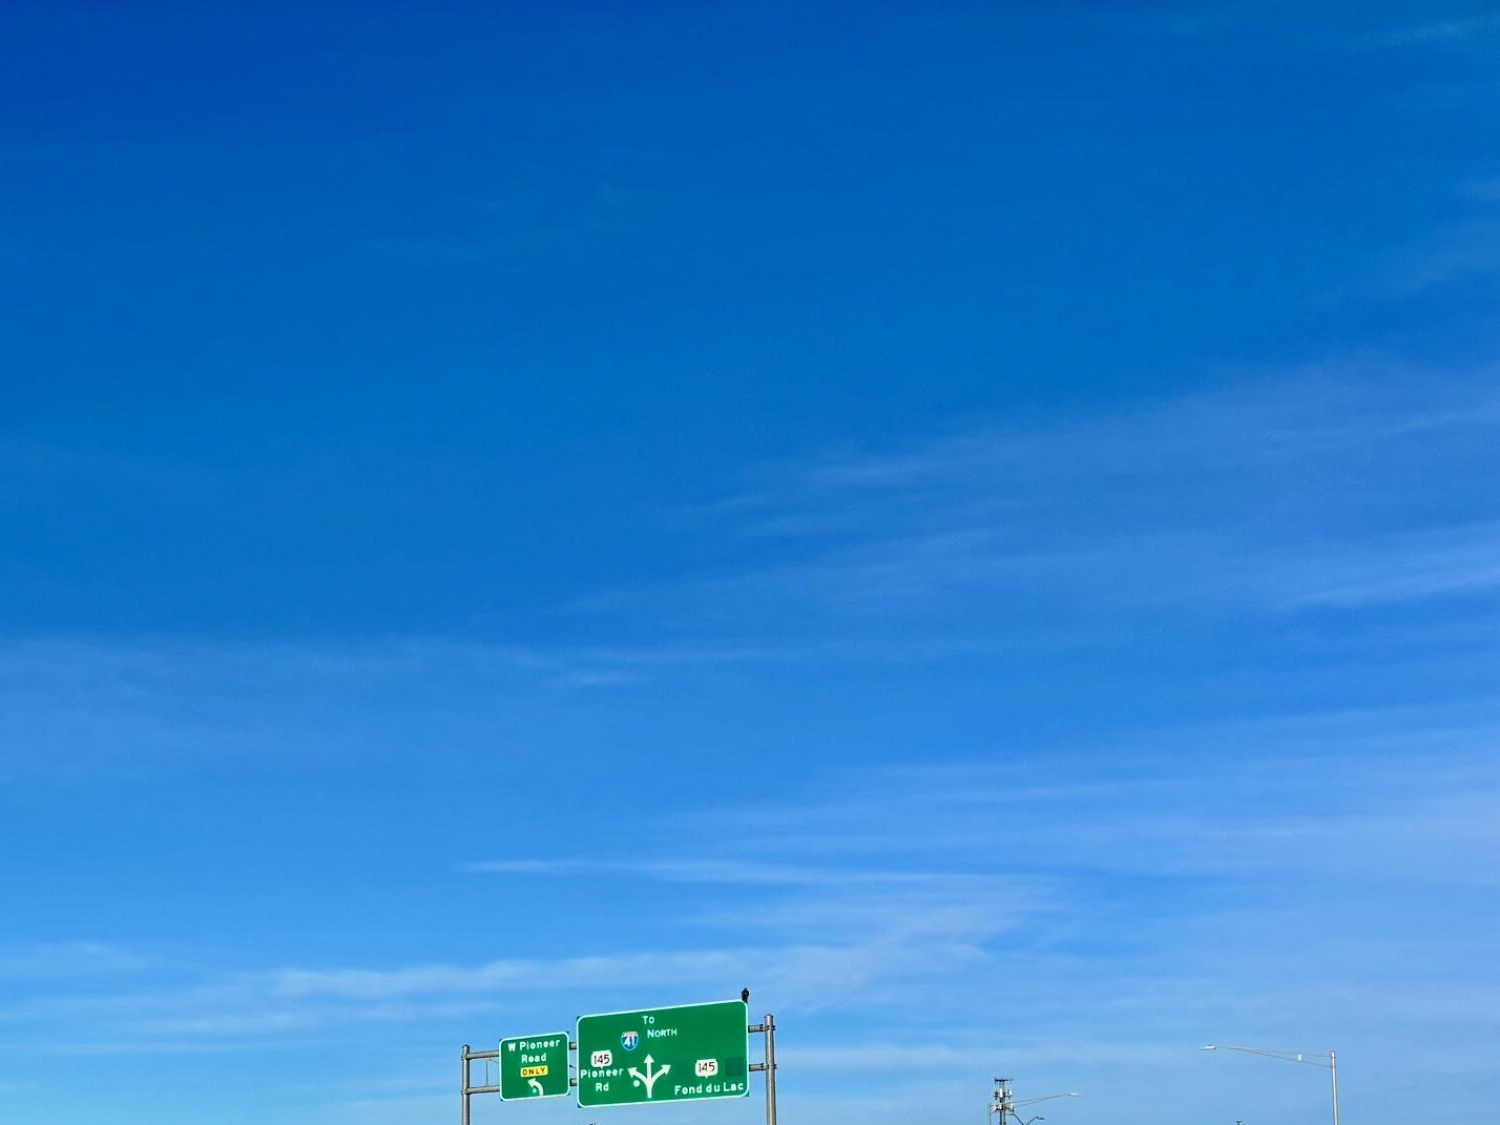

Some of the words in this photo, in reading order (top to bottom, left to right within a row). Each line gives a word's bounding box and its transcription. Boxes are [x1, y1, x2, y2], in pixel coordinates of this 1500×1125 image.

[647, 1028, 678, 1039] NORTH
[507, 1042, 517, 1052] W
[519, 1039, 561, 1051] Pioneer
[623, 1035, 636, 1047] 41
[521, 1052, 547, 1064] Road
[593, 1053, 610, 1065] 145
[522, 1067, 546, 1076] ONLY
[698, 1061, 715, 1073] 145
[580, 1068, 625, 1079] Pioneer
[595, 1082, 610, 1092] Rd
[674, 1084, 703, 1095] Fond
[705, 1083, 721, 1093] du
[723, 1081, 745, 1092] Lac
